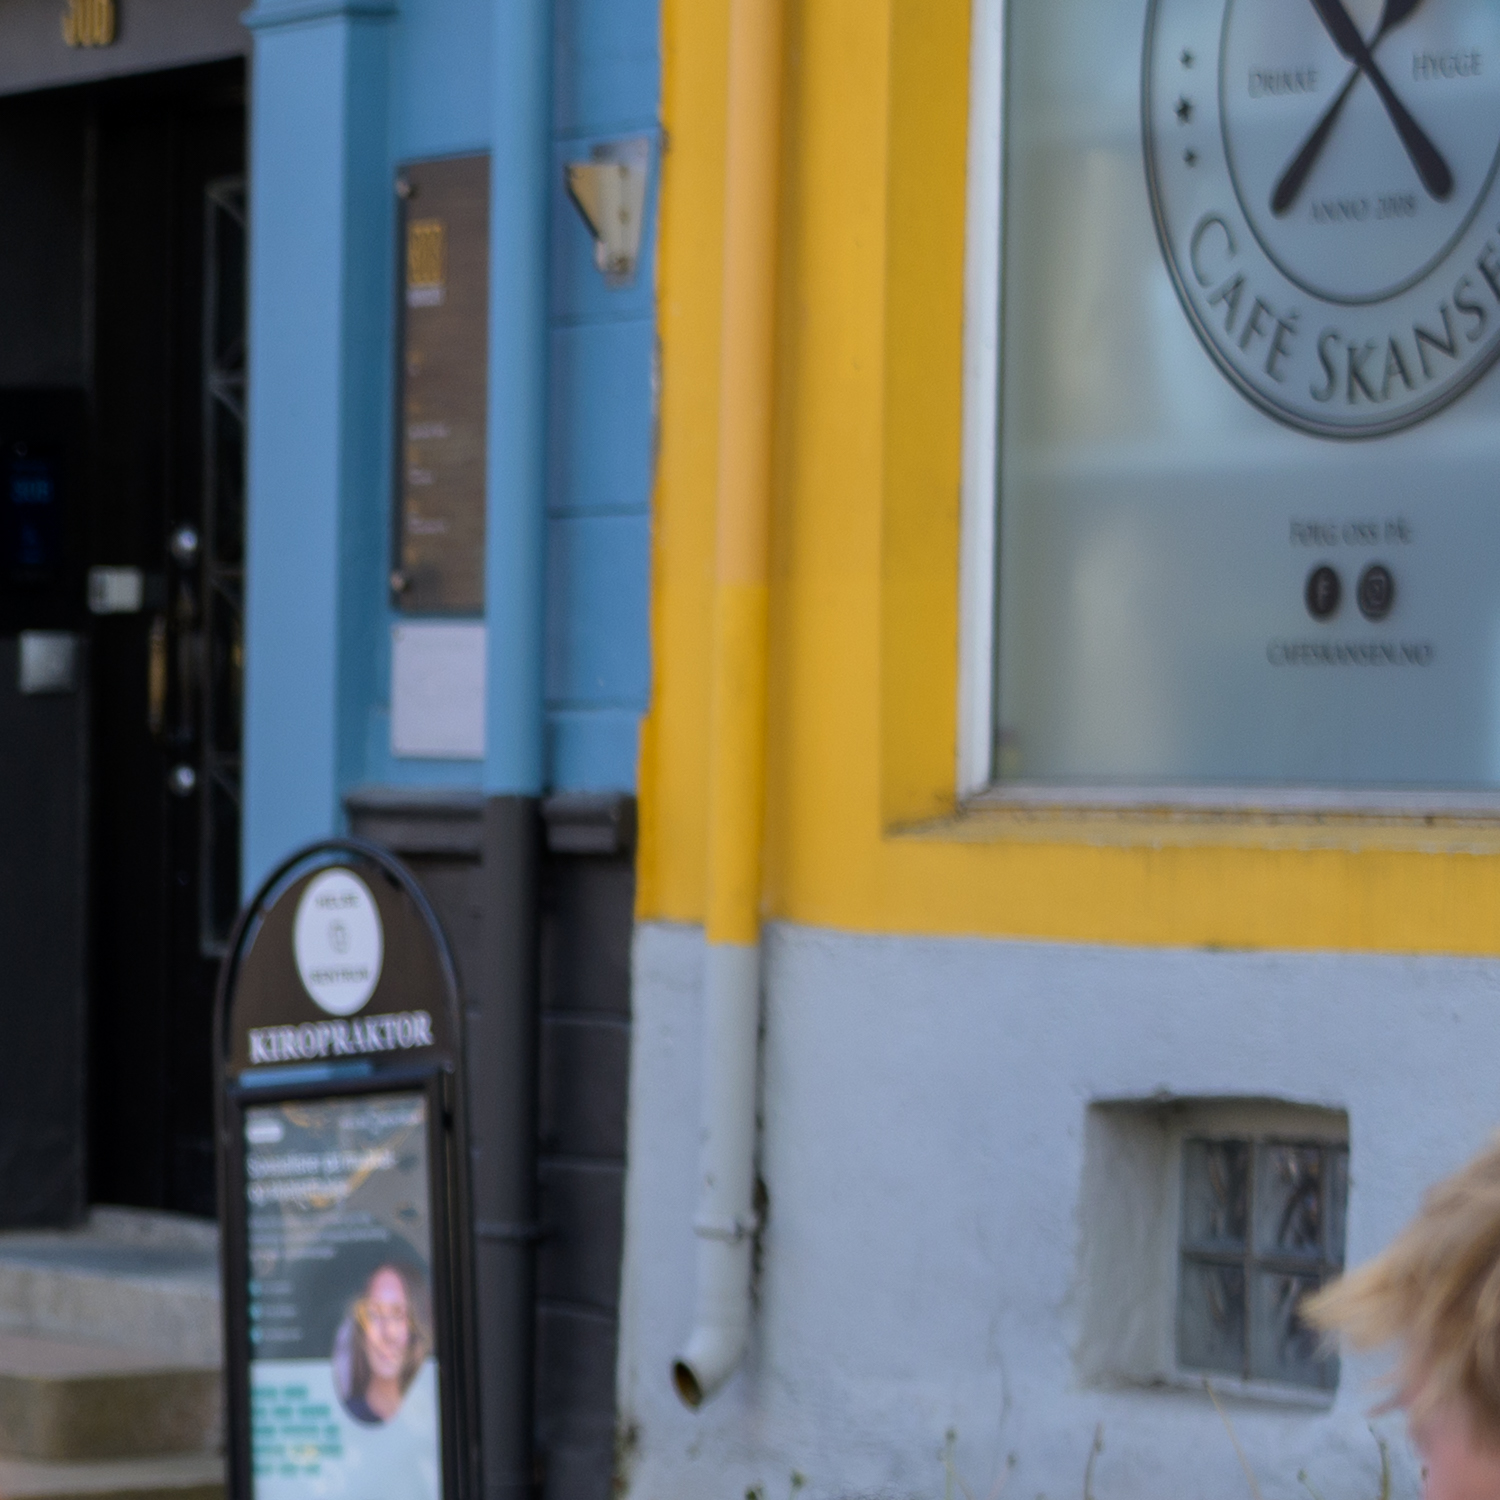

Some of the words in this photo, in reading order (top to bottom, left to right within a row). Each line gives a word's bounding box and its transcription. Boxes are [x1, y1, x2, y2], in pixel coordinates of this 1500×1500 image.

[1412, 51, 1483, 82] HYGGE
[1190, 213, 1298, 383] CAFÉ
[1309, 222, 1500, 405] SKANSE
[249, 1010, 435, 1065] KIROPRAKTOR
